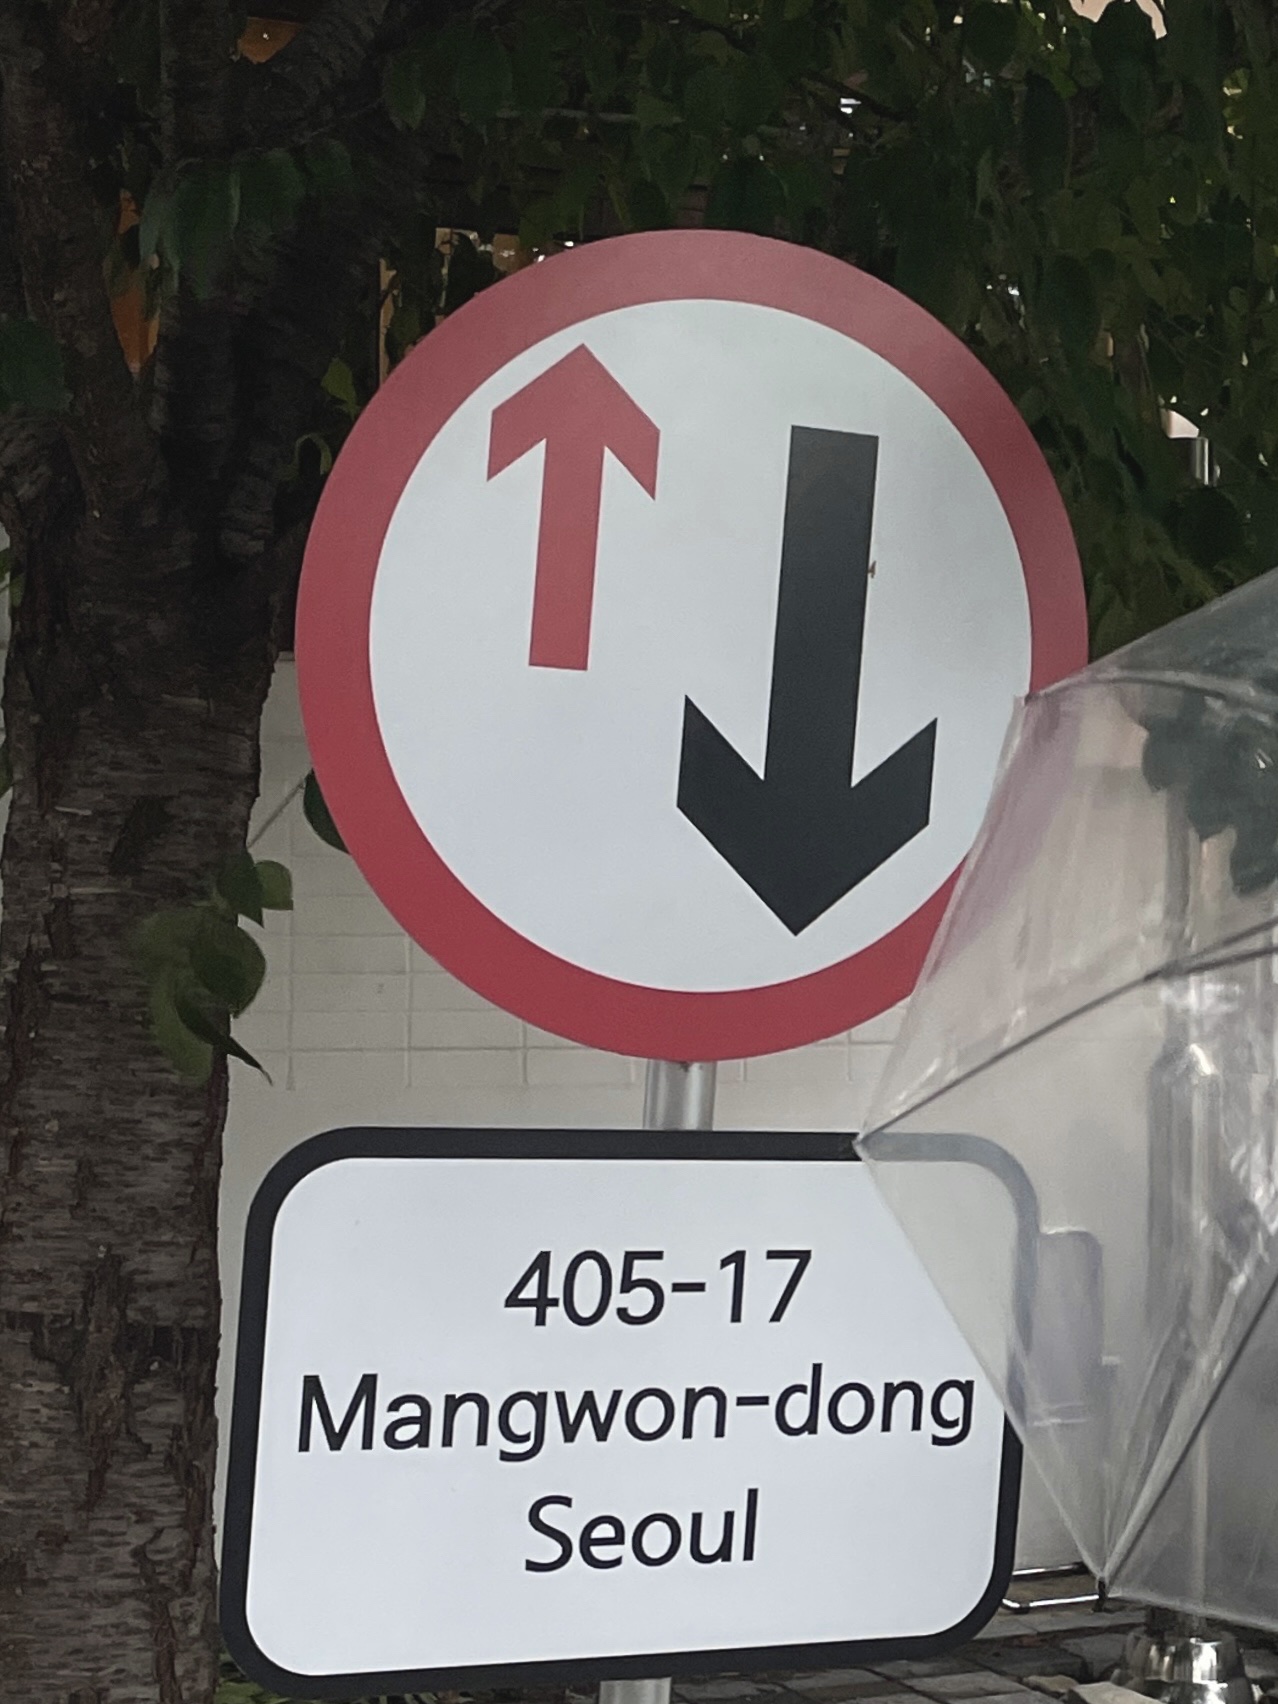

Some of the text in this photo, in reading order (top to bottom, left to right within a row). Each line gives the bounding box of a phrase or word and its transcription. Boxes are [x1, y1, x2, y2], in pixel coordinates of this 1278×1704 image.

[504, 1249, 812, 1327] 405-17
[298, 1362, 975, 1463] Mangwon-dong
[525, 1488, 759, 1573] Seoul
